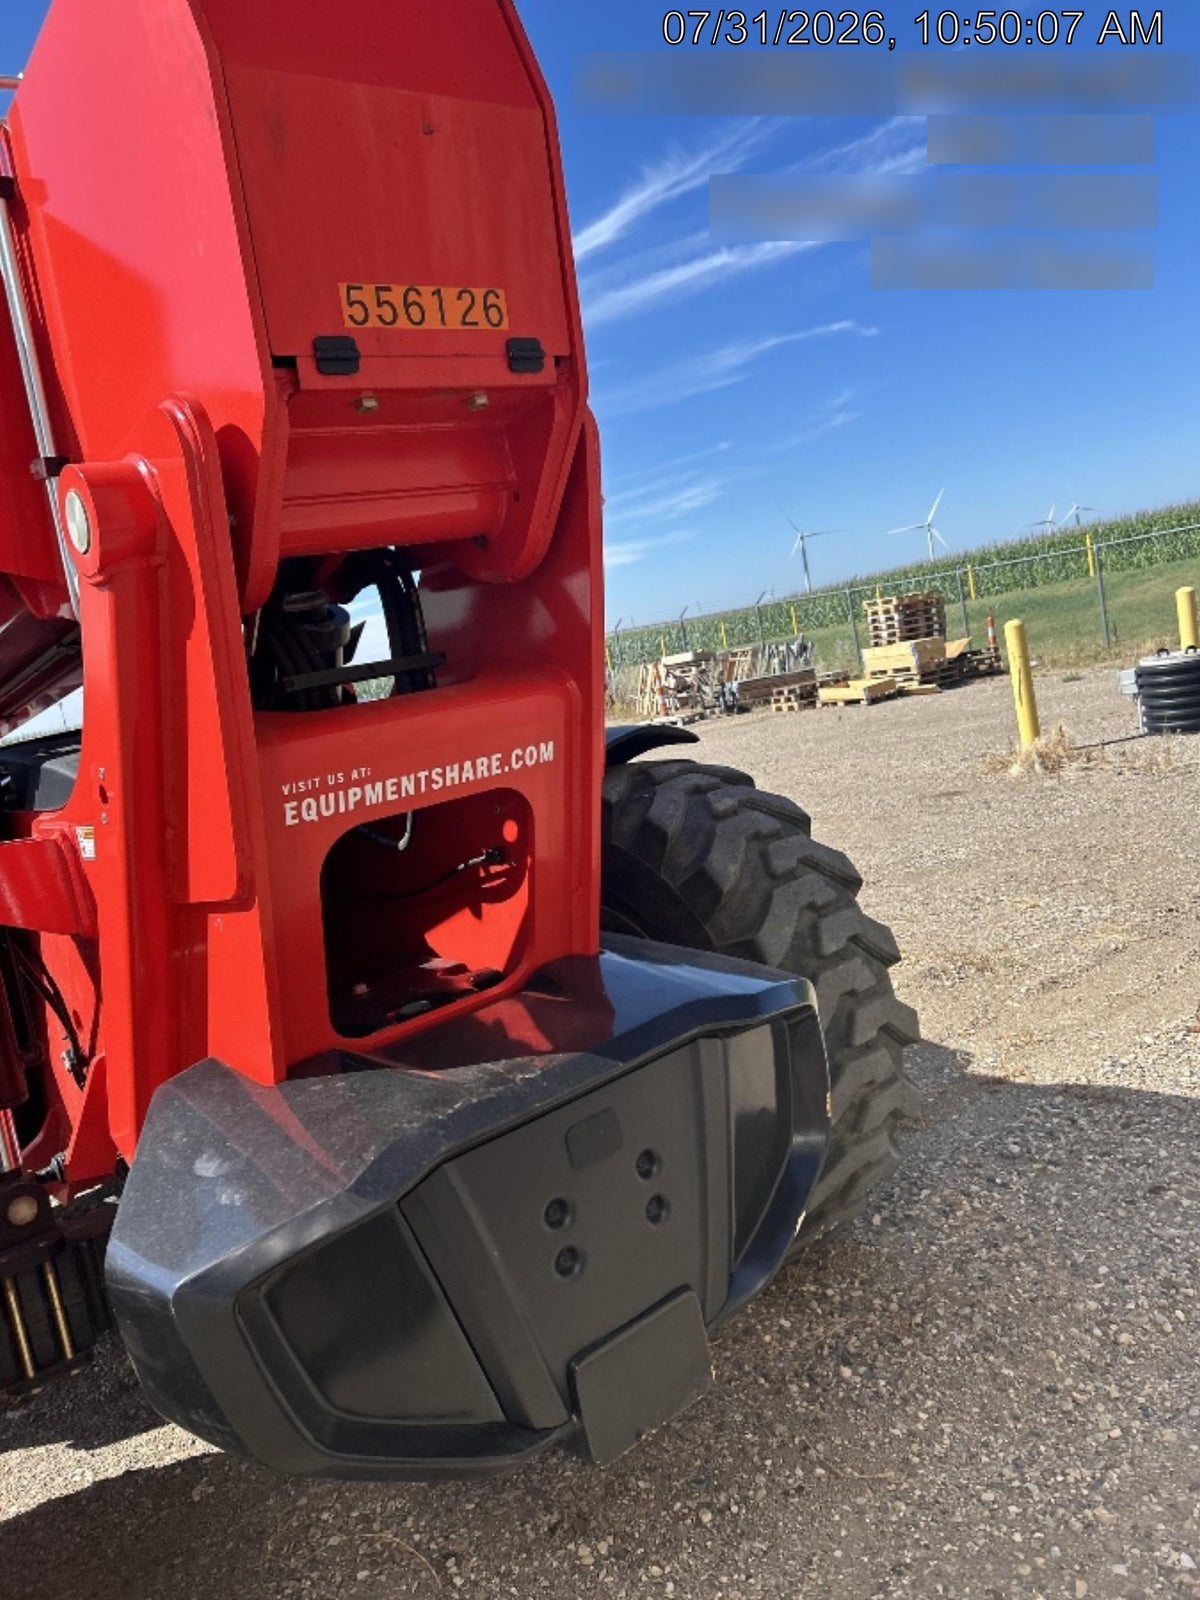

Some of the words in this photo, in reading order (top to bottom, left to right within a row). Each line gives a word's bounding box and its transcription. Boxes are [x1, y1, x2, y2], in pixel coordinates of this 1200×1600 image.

[346, 284, 503, 327] 556126
[282, 777, 321, 796] VISIT
[328, 773, 344, 786] US
[351, 767, 371, 781] AT:
[284, 741, 554, 826] EQUIPMENTSHARE.COM
